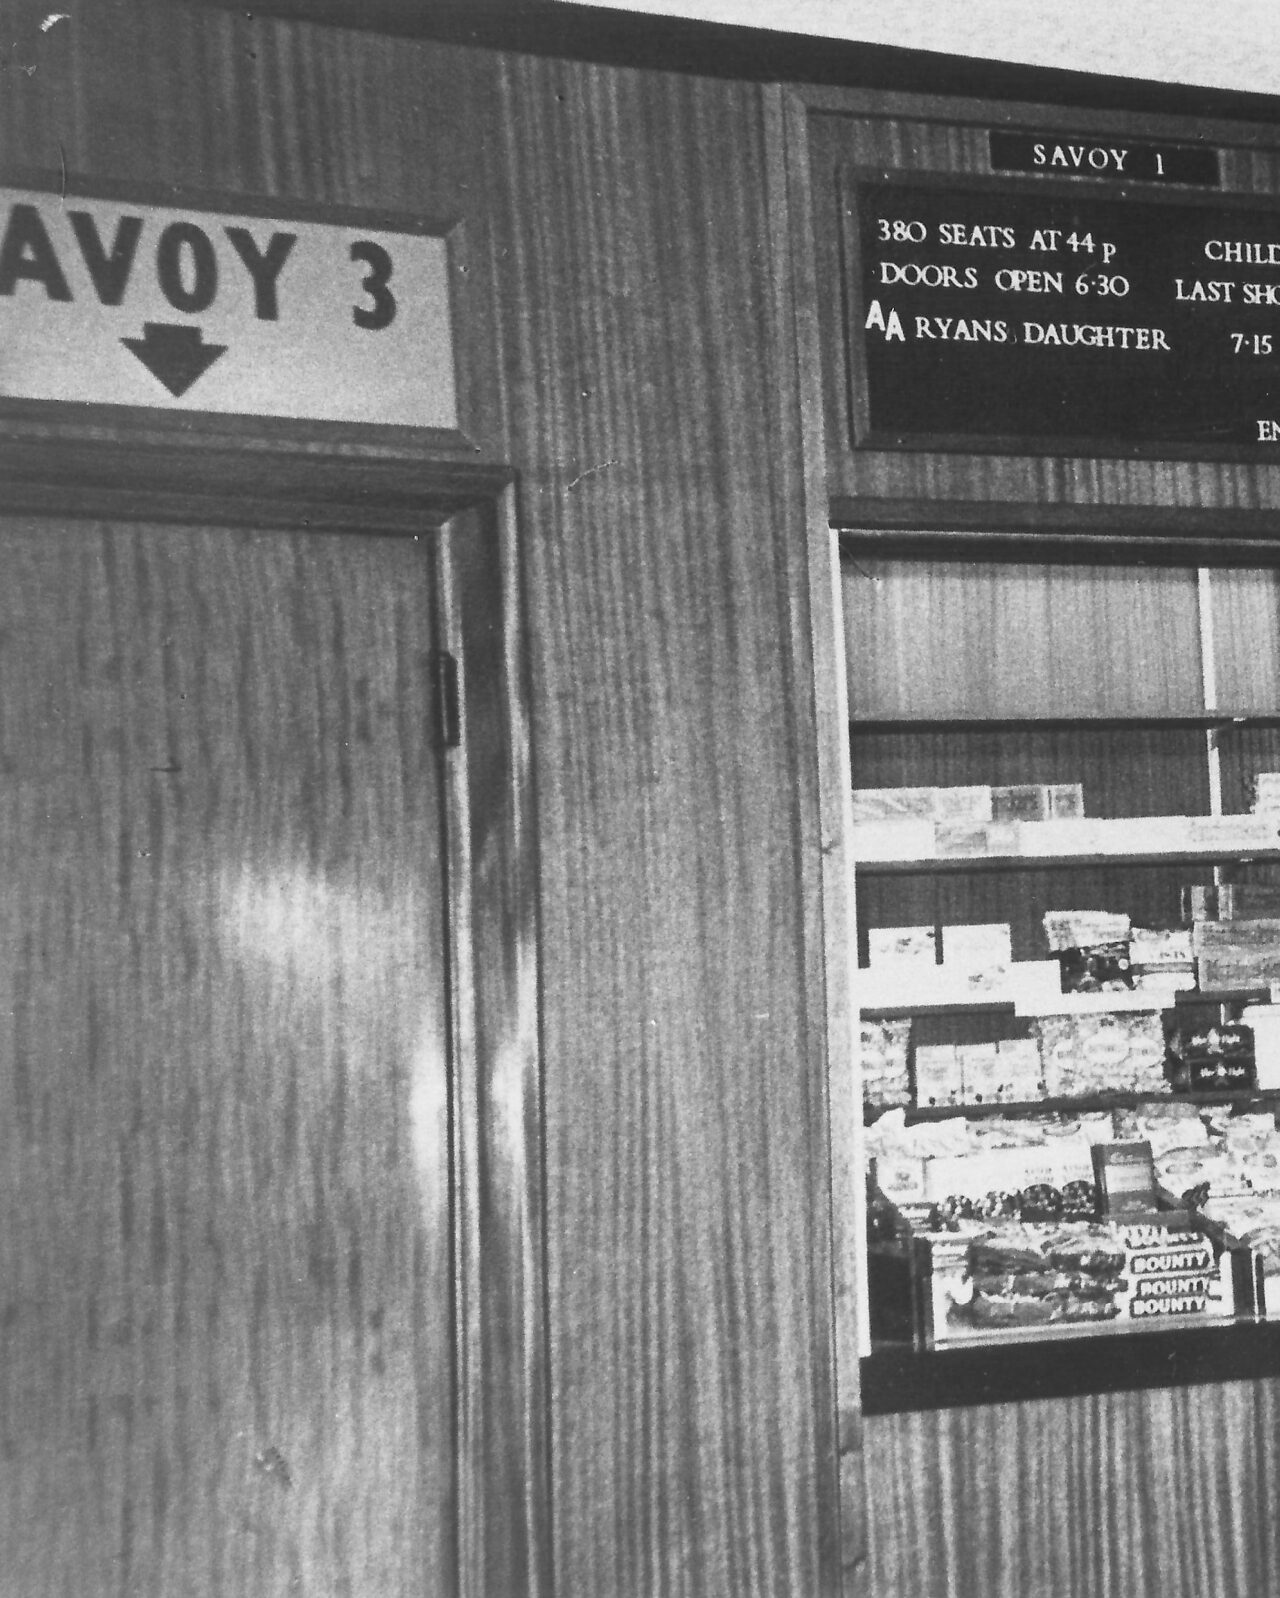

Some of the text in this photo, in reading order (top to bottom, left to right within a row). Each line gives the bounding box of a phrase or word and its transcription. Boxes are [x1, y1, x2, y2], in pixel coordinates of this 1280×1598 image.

[1033, 144, 1128, 171] SAVOY
[877, 220, 927, 242] 380
[939, 224, 1016, 249] SEATS
[1030, 230, 1062, 252] AT
[349, 240, 397, 331] 3
[880, 263, 978, 289] DOORS
[995, 271, 1064, 294] OPEN
[1175, 279, 1236, 303] LAST
[914, 316, 1008, 343] RYANS
[1024, 323, 1171, 350] DAUGHTER
[1133, 1251, 1207, 1273] BOUNTY
[1139, 1276, 1209, 1297] BOUNTY
[1133, 1296, 1207, 1315] BOUNTY
